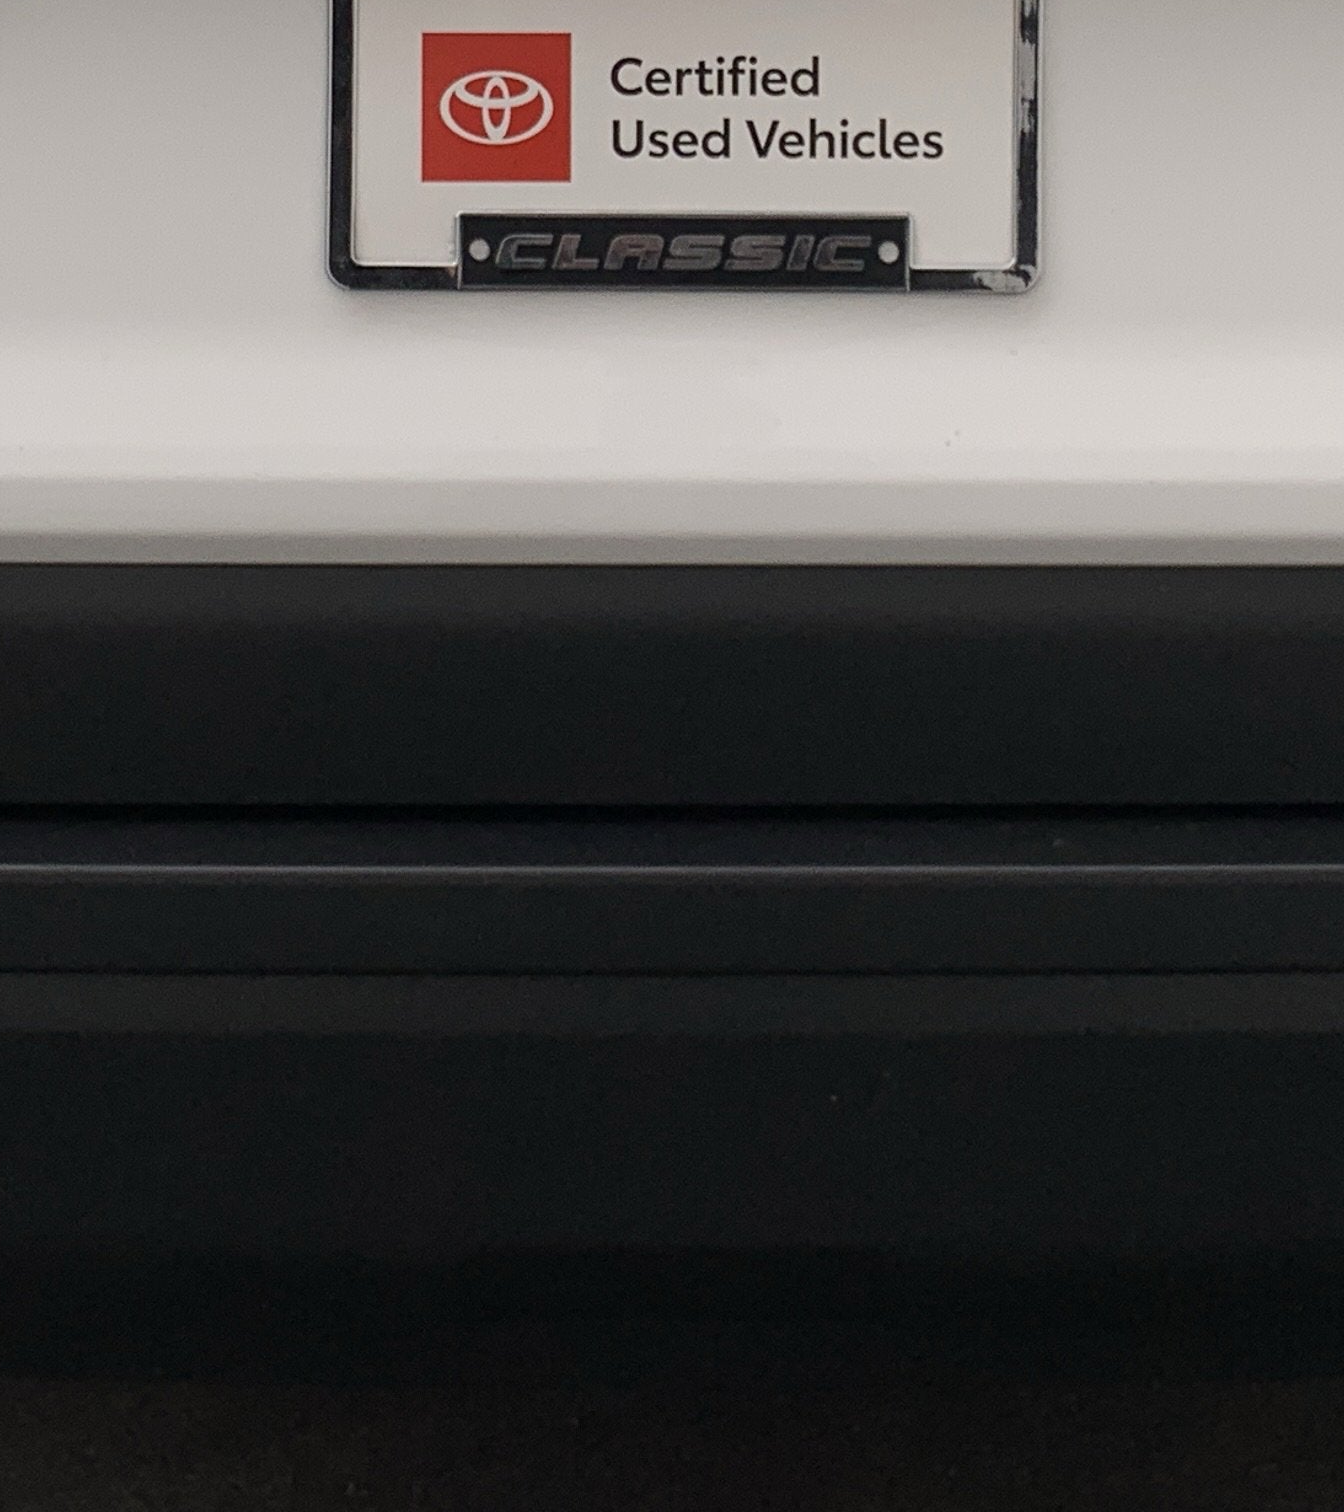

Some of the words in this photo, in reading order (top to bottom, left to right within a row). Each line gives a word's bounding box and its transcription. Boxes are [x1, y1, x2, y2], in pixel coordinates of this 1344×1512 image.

[610, 55, 820, 97] Certified
[612, 117, 731, 159] Used
[744, 117, 944, 159] Vehicles
[495, 233, 872, 272] CLASSIC
